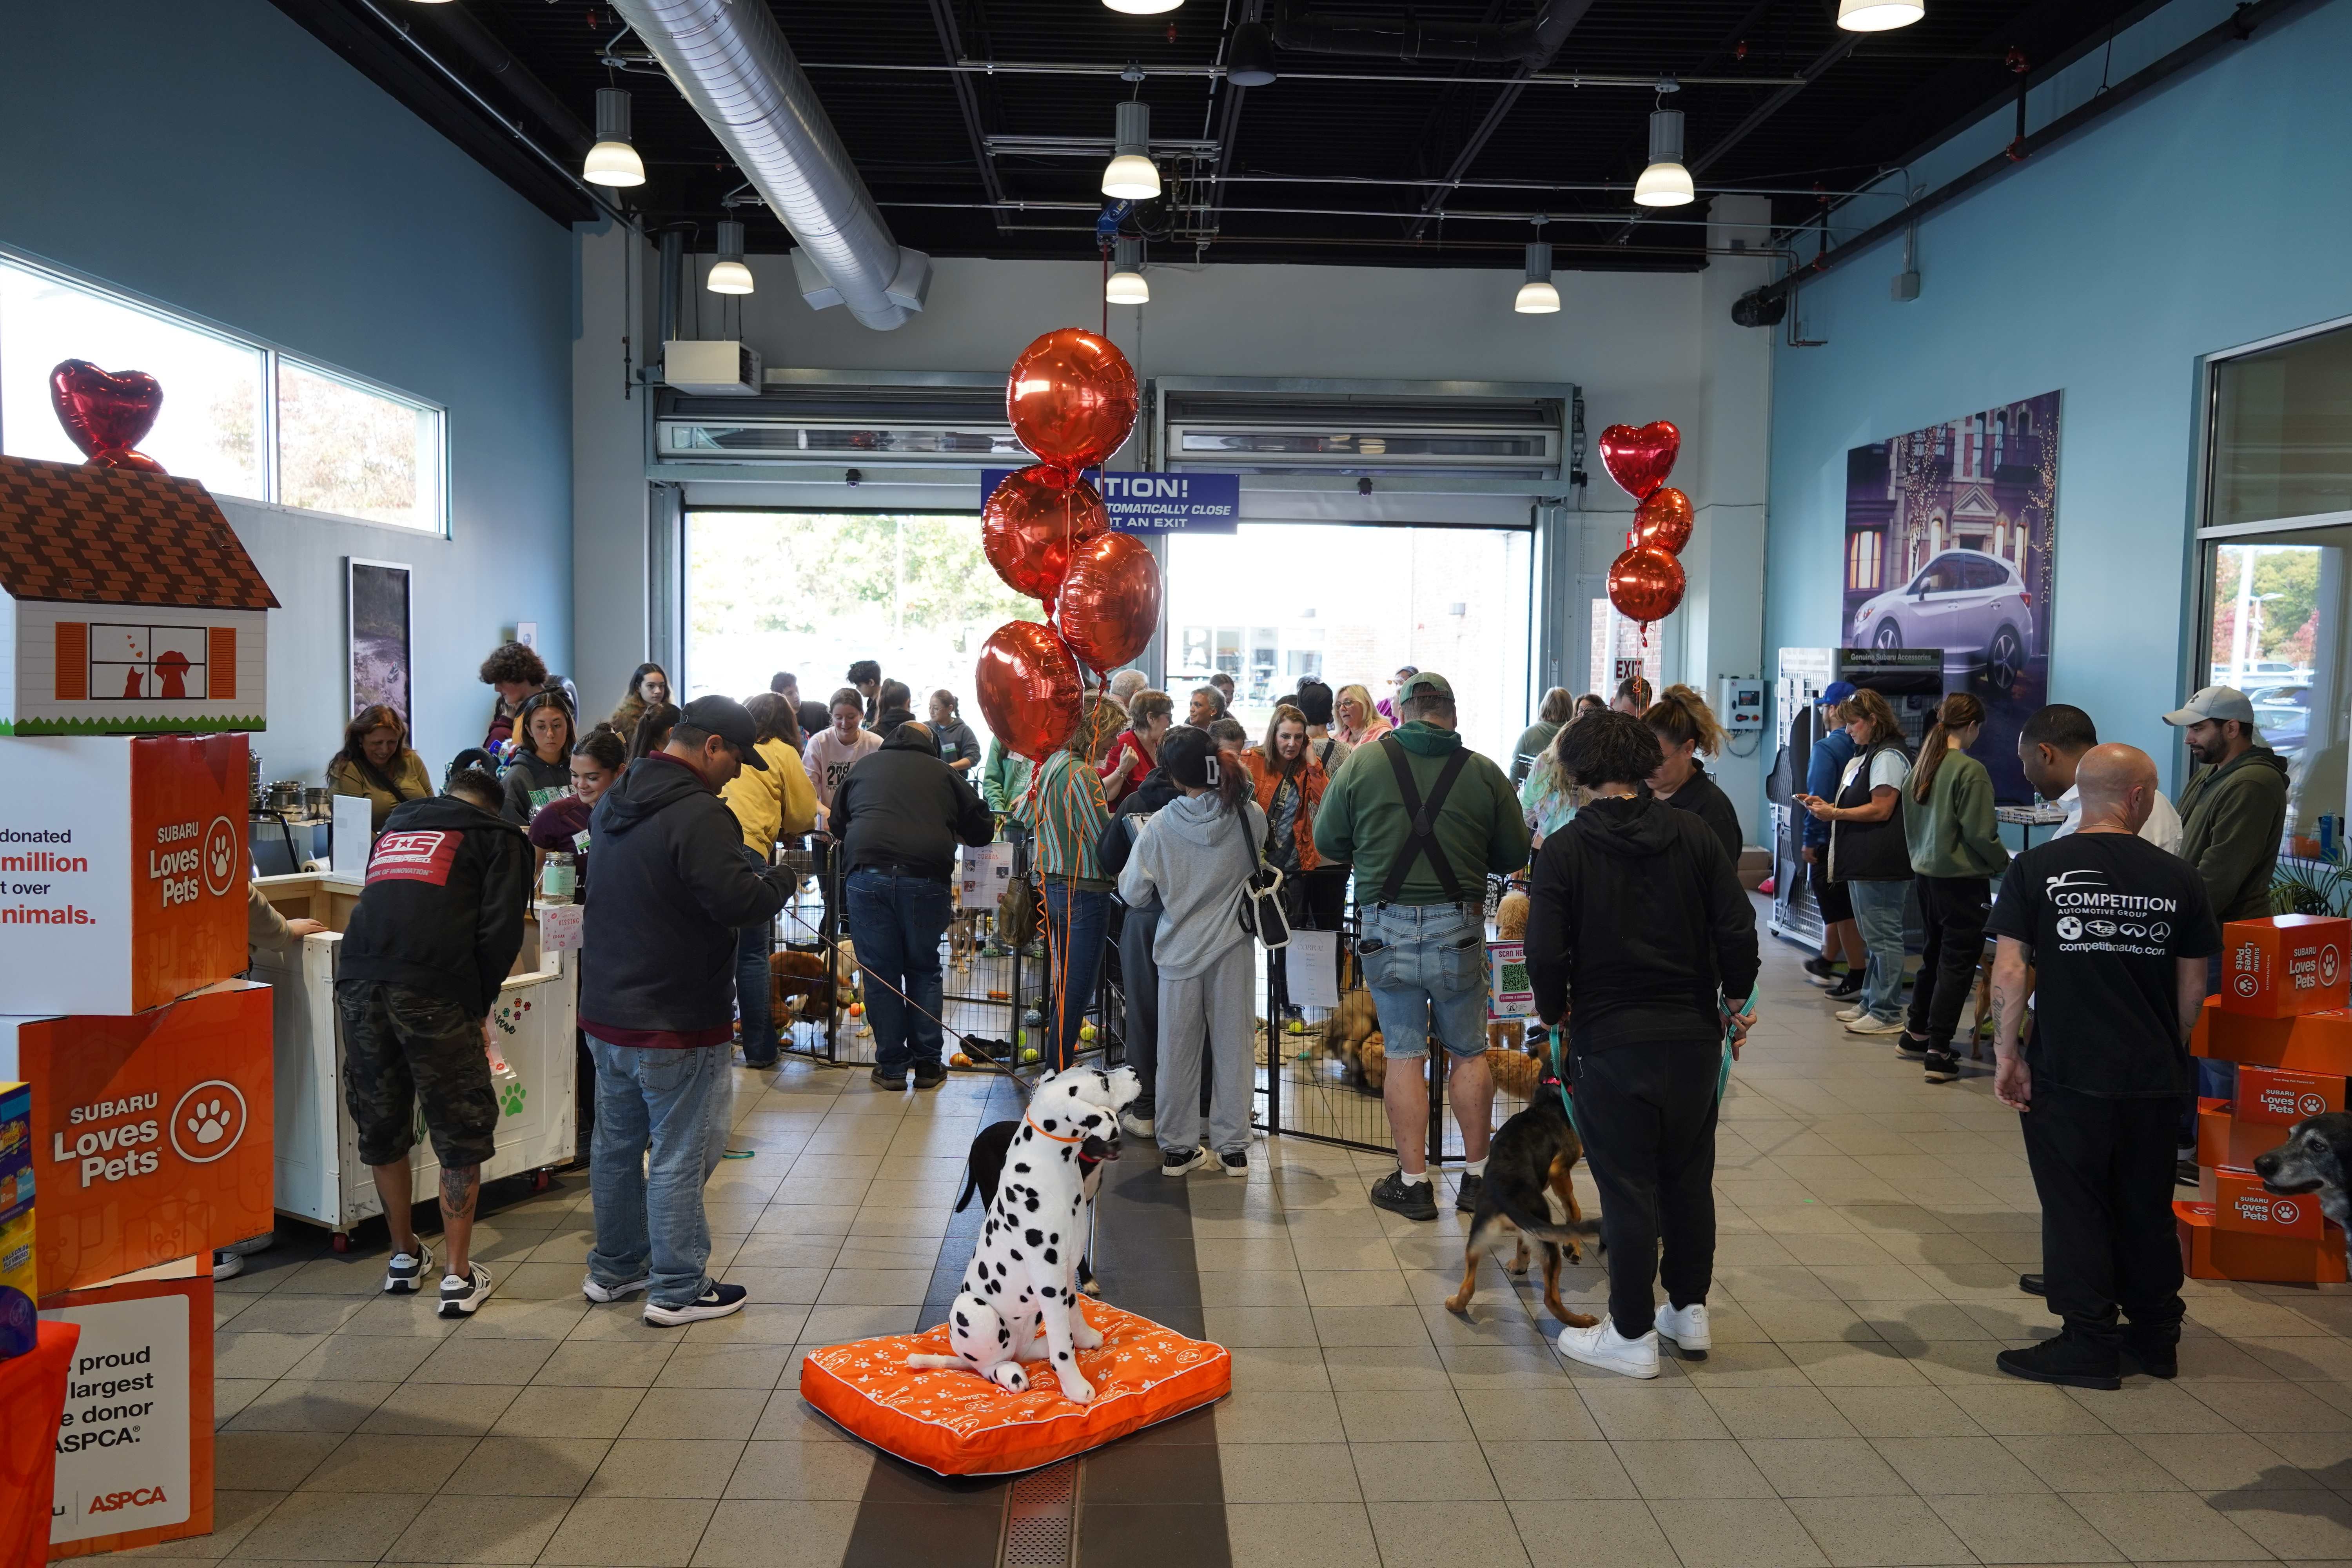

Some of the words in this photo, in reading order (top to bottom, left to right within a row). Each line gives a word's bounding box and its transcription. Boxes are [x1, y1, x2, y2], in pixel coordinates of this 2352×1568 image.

[1105, 503, 1189, 515] TOMATICALLY
[1191, 505, 1232, 515] CLOSE
[1127, 518, 1149, 527] AN
[1154, 518, 1188, 528] EXIT
[1616, 661, 1642, 678] EXIT
[0, 828, 71, 843] donated
[158, 821, 199, 844] SUBARU
[2, 852, 88, 872] million
[150, 848, 199, 879] Loves
[12, 884, 51, 895] over
[2055, 893, 2176, 913] COMPETITION
[0, 904, 96, 924] nimals.
[2117, 909, 2148, 918] GROUP
[558, 918, 580, 926] KISSING
[2236, 948, 2245, 970] Pets
[2244, 942, 2254, 971] Loves
[2294, 946, 2317, 957] SUBARU
[2289, 960, 2316, 975] Loves
[2295, 974, 2315, 989] Pets
[2261, 1094, 2294, 1105] Loves
[71, 1092, 158, 1124] SUBARU
[2269, 1103, 2294, 1114] Pets
[54, 1119, 158, 1163] Loves
[2234, 1201, 2269, 1212] Loves
[2243, 1210, 2268, 1221] Pets
[80, 1346, 151, 1375] proud
[71, 1372, 154, 1399] largest
[953, 1392, 990, 1402] SUBARU
[82, 1401, 154, 1424] donor
[88, 1486, 167, 1515] ASPCA
